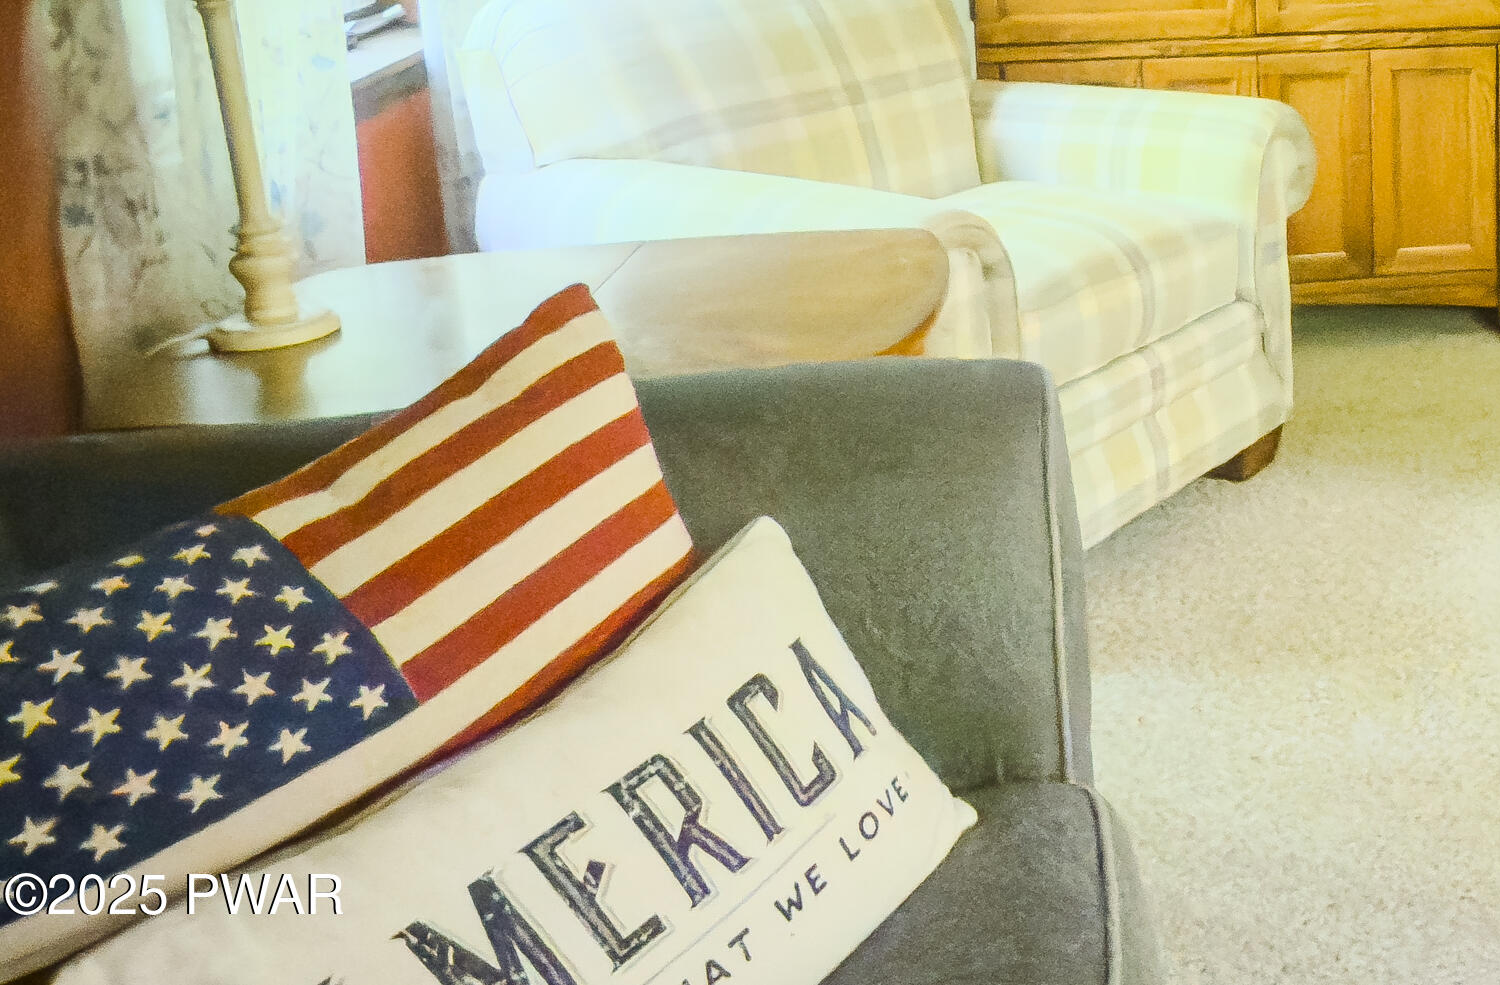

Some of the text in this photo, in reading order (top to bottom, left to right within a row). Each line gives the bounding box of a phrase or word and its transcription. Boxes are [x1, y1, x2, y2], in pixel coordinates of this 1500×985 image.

[316, 637, 877, 985] MERICA
[682, 776, 909, 985] AT WE LOVE
